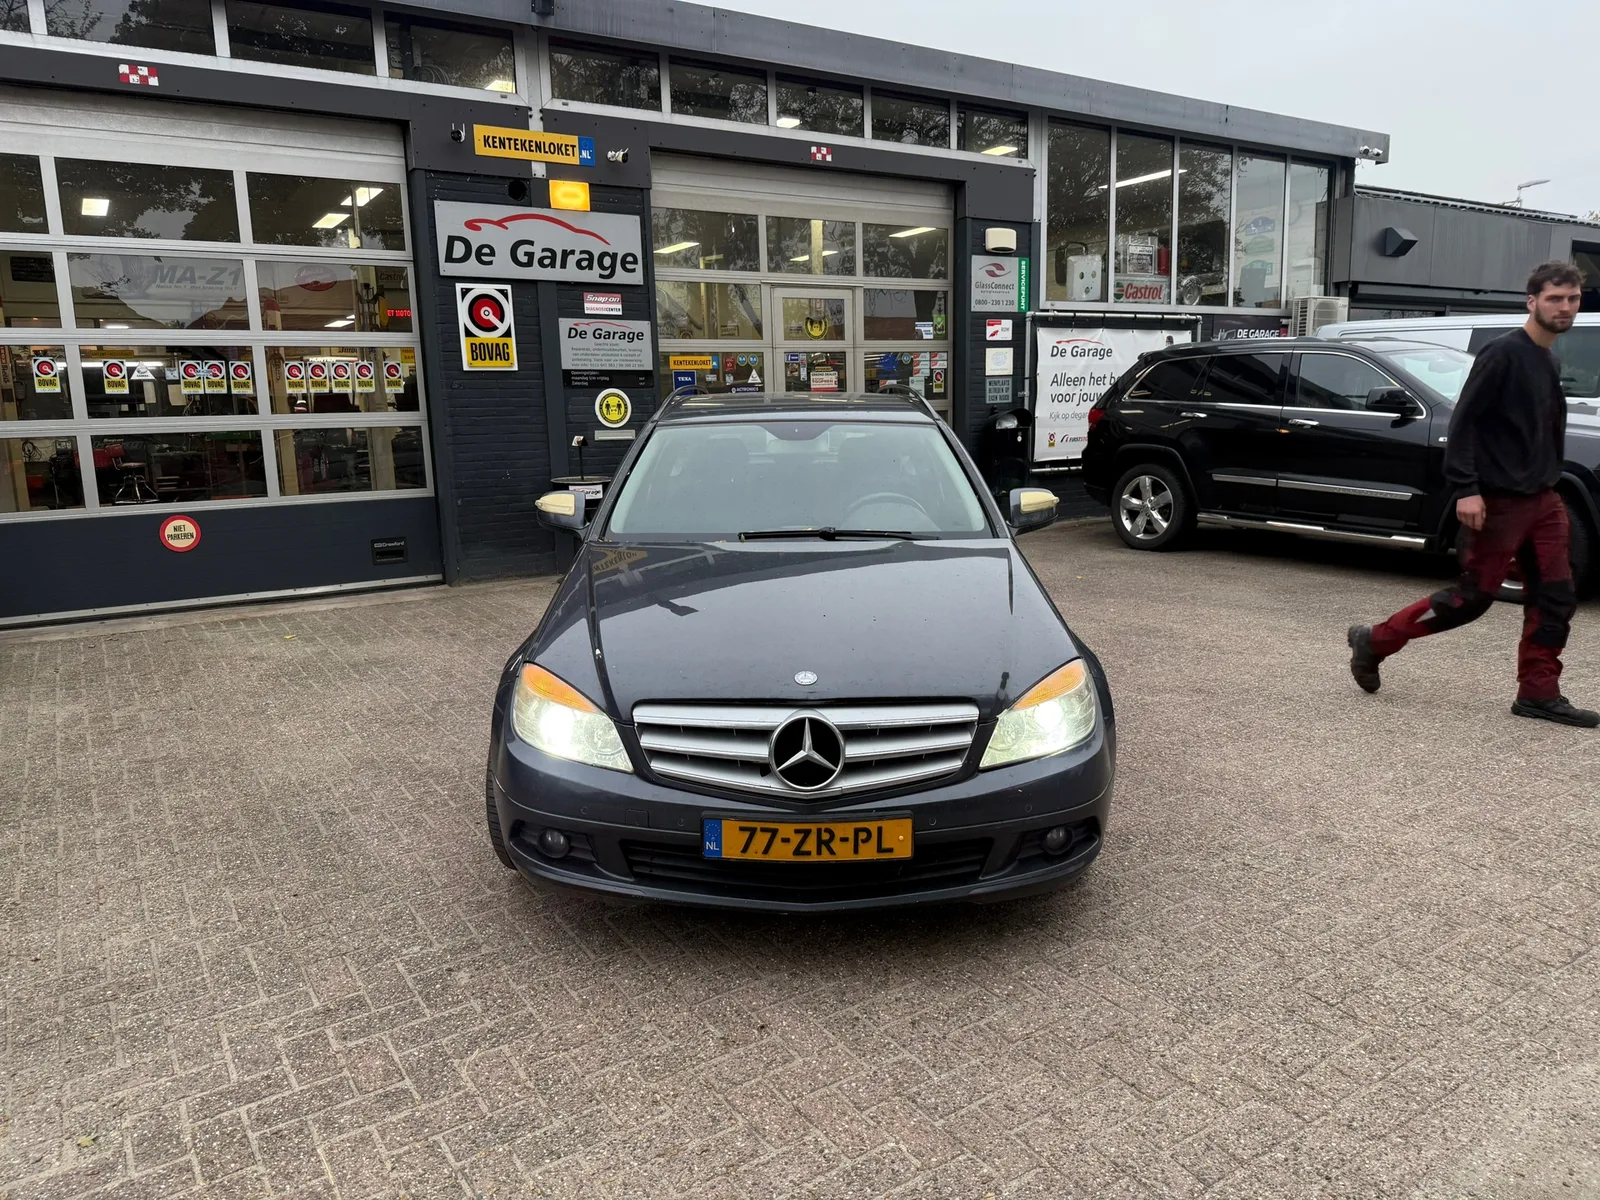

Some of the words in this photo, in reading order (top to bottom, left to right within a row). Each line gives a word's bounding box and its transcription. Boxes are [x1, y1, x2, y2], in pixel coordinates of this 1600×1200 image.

[483, 134, 576, 157] KENTEKENLOKET
[444, 235, 496, 265] De
[510, 239, 639, 279] Garage
[155, 265, 241, 285] MA-Z1
[380, 273, 405, 281] Castro
[975, 281, 1014, 290] GlassConnect
[1125, 283, 1163, 300] Castrol
[567, 327, 587, 339] De
[592, 328, 644, 343] Garage
[1237, 329, 1248, 338] DE
[1249, 330, 1280, 338] GARAGE
[470, 342, 510, 361] BOVAG
[1051, 345, 1066, 357] De
[1071, 346, 1113, 360] Garage
[37, 379, 57, 387] BOVAG
[1050, 372, 1086, 386] Alleen
[1089, 372, 1107, 386] het
[1050, 392, 1076, 403] voor
[1050, 411, 1060, 421] Kijk
[1061, 413, 1069, 421] op
[167, 532, 195, 541] PARKEREN
[706, 841, 719, 850] NL
[738, 826, 894, 856] 77-ZR-PL
